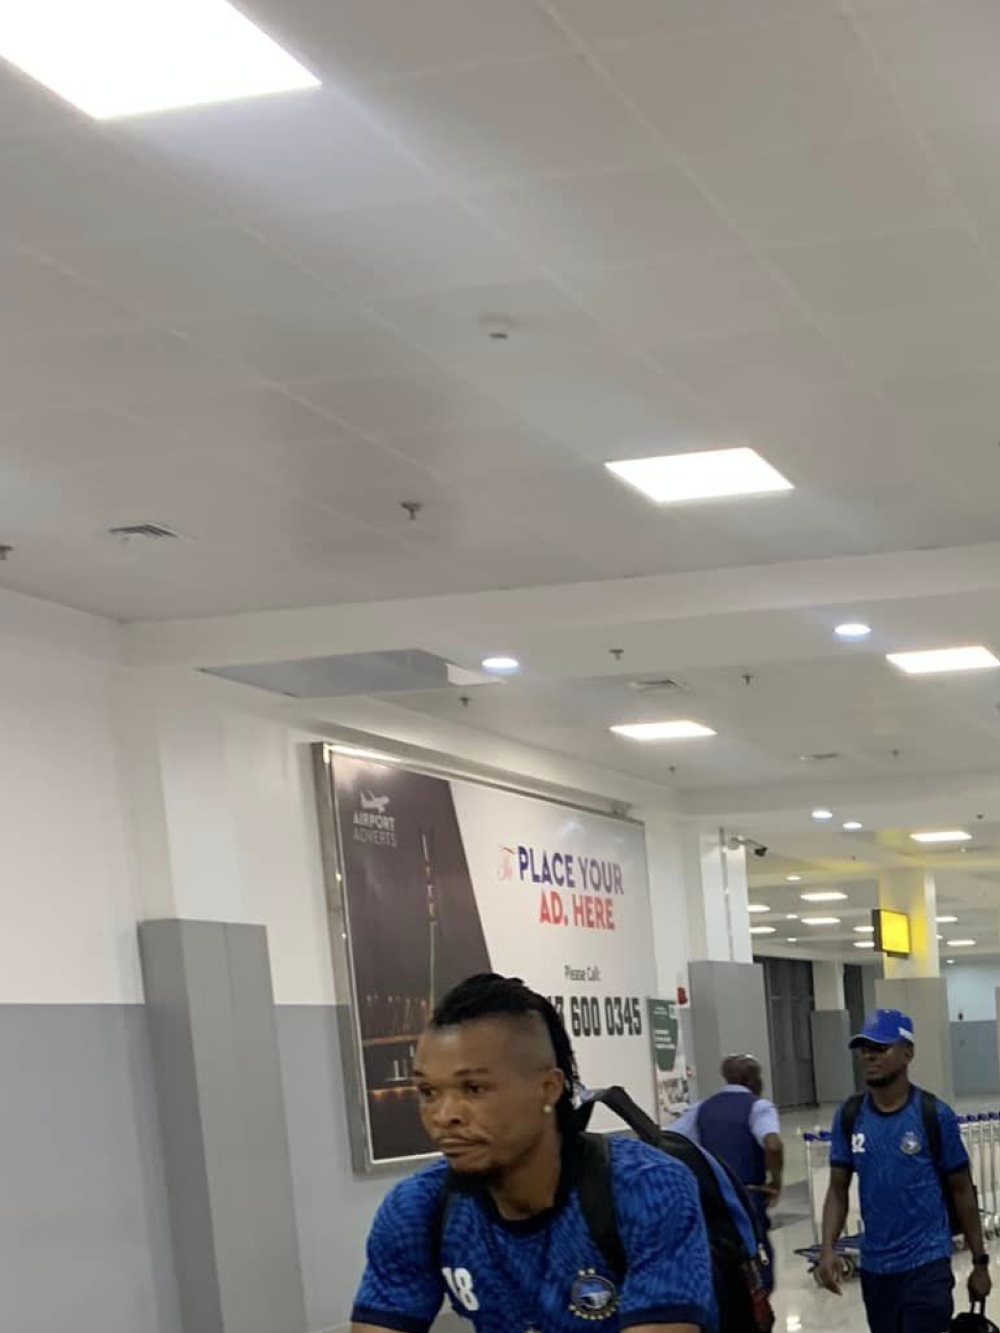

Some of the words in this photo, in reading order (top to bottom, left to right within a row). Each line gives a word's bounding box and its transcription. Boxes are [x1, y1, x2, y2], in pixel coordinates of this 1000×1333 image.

[353, 810, 395, 831] AIRPORT
[518, 845, 575, 888] PLACE
[578, 857, 624, 895] YOUR
[540, 890, 568, 926] AD.
[572, 893, 615, 930] HERE
[571, 996, 601, 1037] 600
[605, 997, 641, 1036] 0345
[442, 1267, 479, 1311] 18
